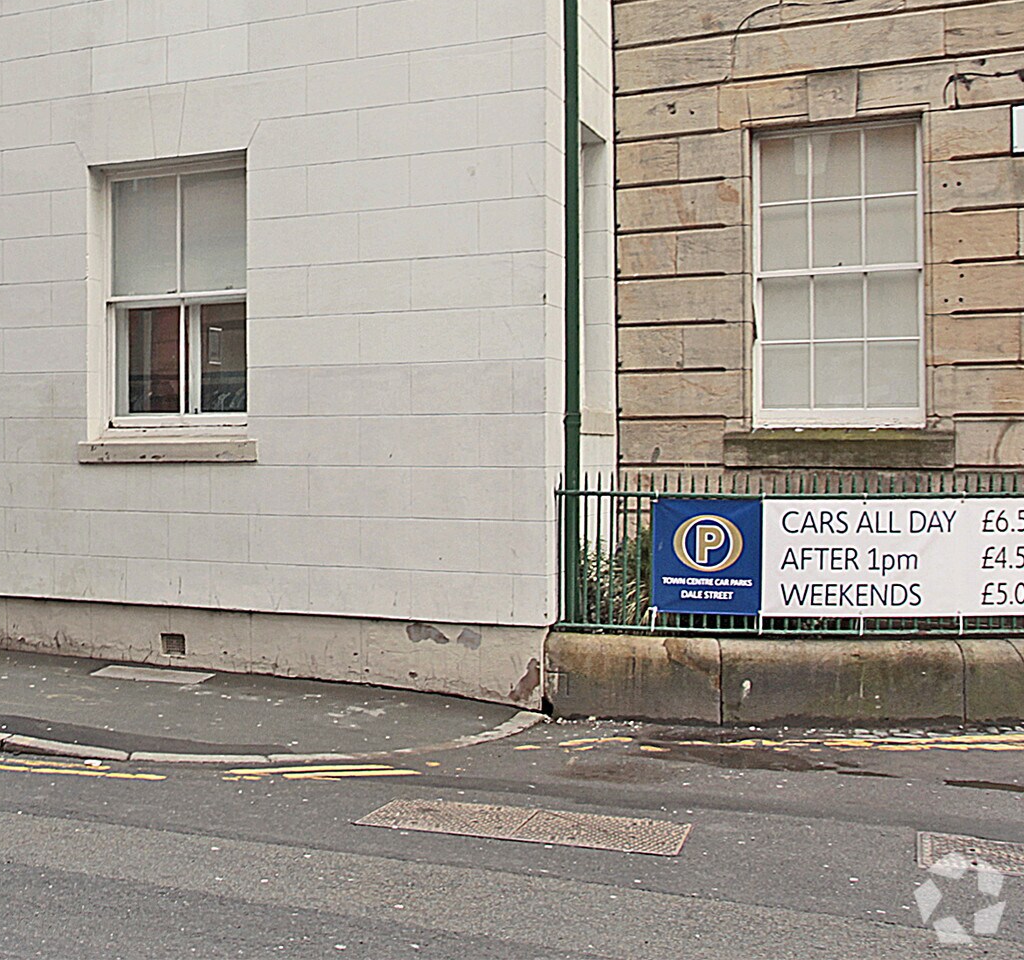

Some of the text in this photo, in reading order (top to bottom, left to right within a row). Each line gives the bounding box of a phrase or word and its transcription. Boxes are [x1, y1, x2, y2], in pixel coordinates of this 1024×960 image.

[782, 511, 957, 533] CARS ALL DAY
[981, 510, 1024, 533] £6.5
[696, 525, 725, 563] P
[781, 547, 918, 576] AFTER 1pm
[981, 546, 1024, 569] £4.5
[687, 578, 713, 586] CENTRE
[981, 582, 1024, 605] £5.0
[681, 590, 734, 600] DALE STREET
[781, 584, 922, 606] WEEKENDS
